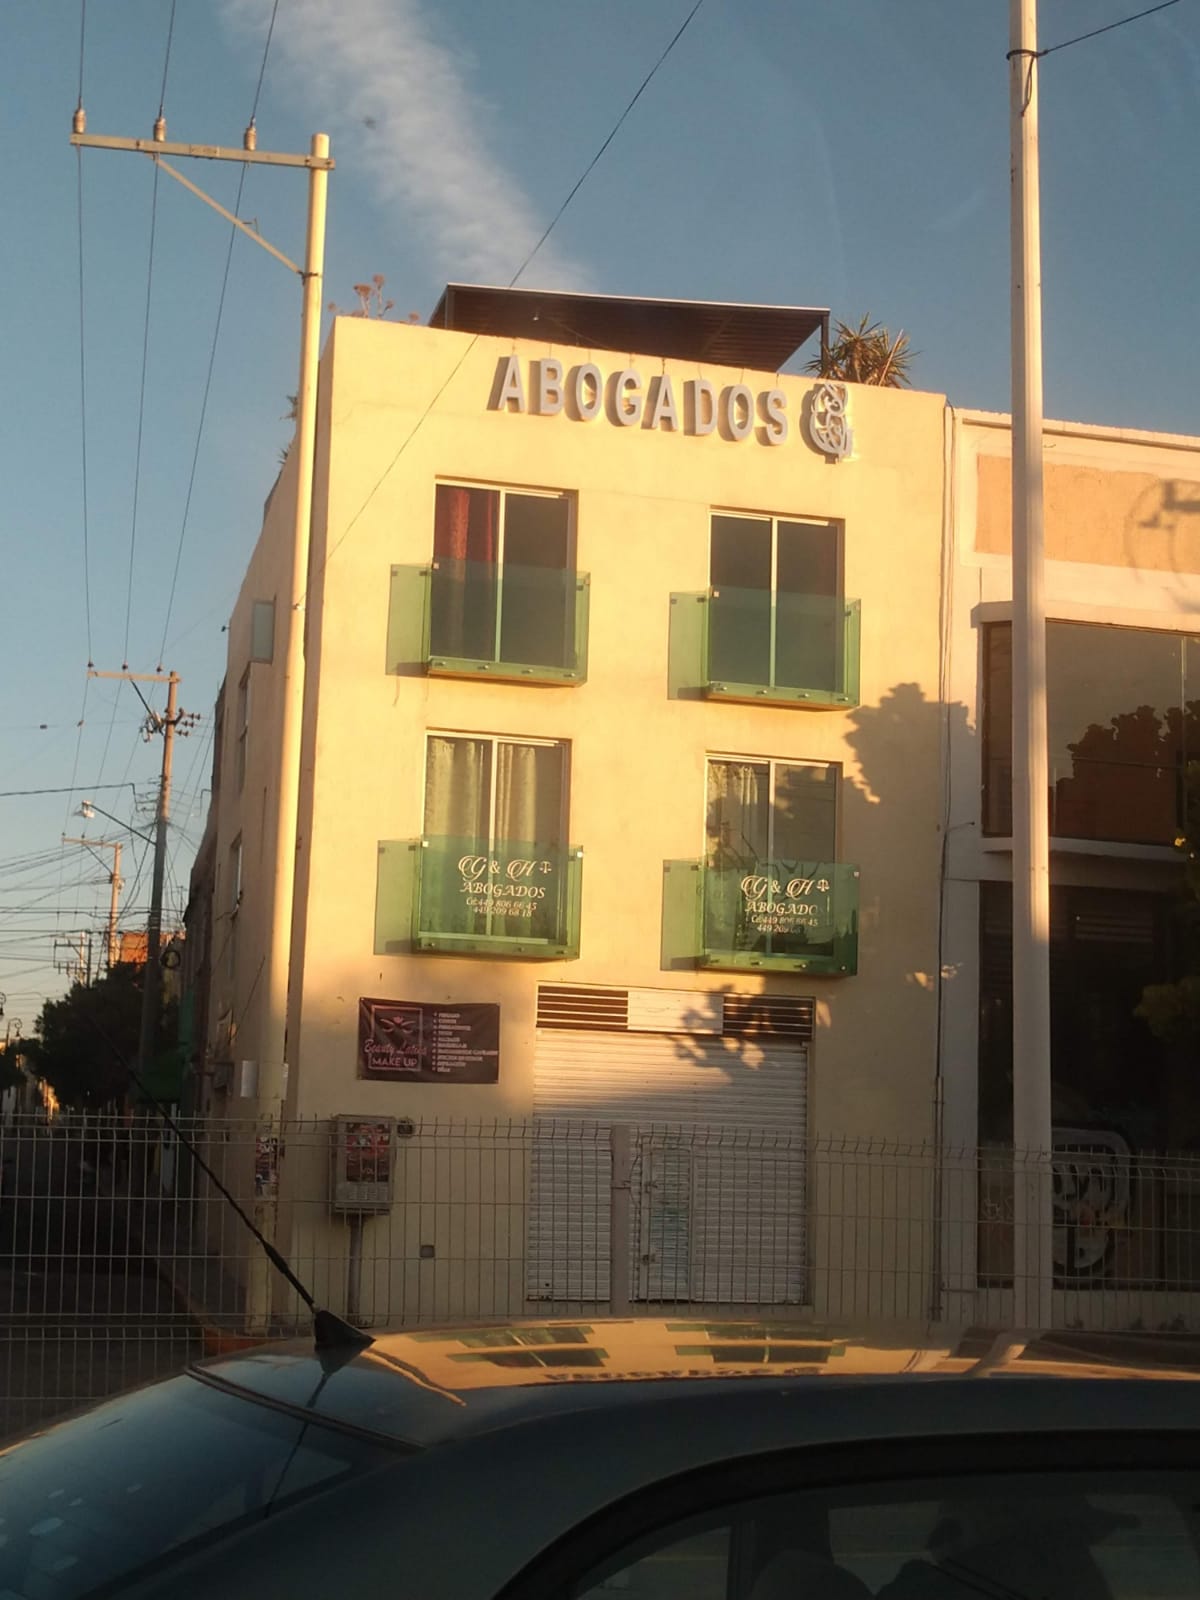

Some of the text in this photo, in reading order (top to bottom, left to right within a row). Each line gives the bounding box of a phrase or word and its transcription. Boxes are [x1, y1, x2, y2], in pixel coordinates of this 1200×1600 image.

[487, 354, 788, 446] ABOGADOS
[460, 881, 546, 899] ABOGADOS
[745, 901, 823, 916] ABOGADO
[372, 1057, 417, 1067] MAKE UP
